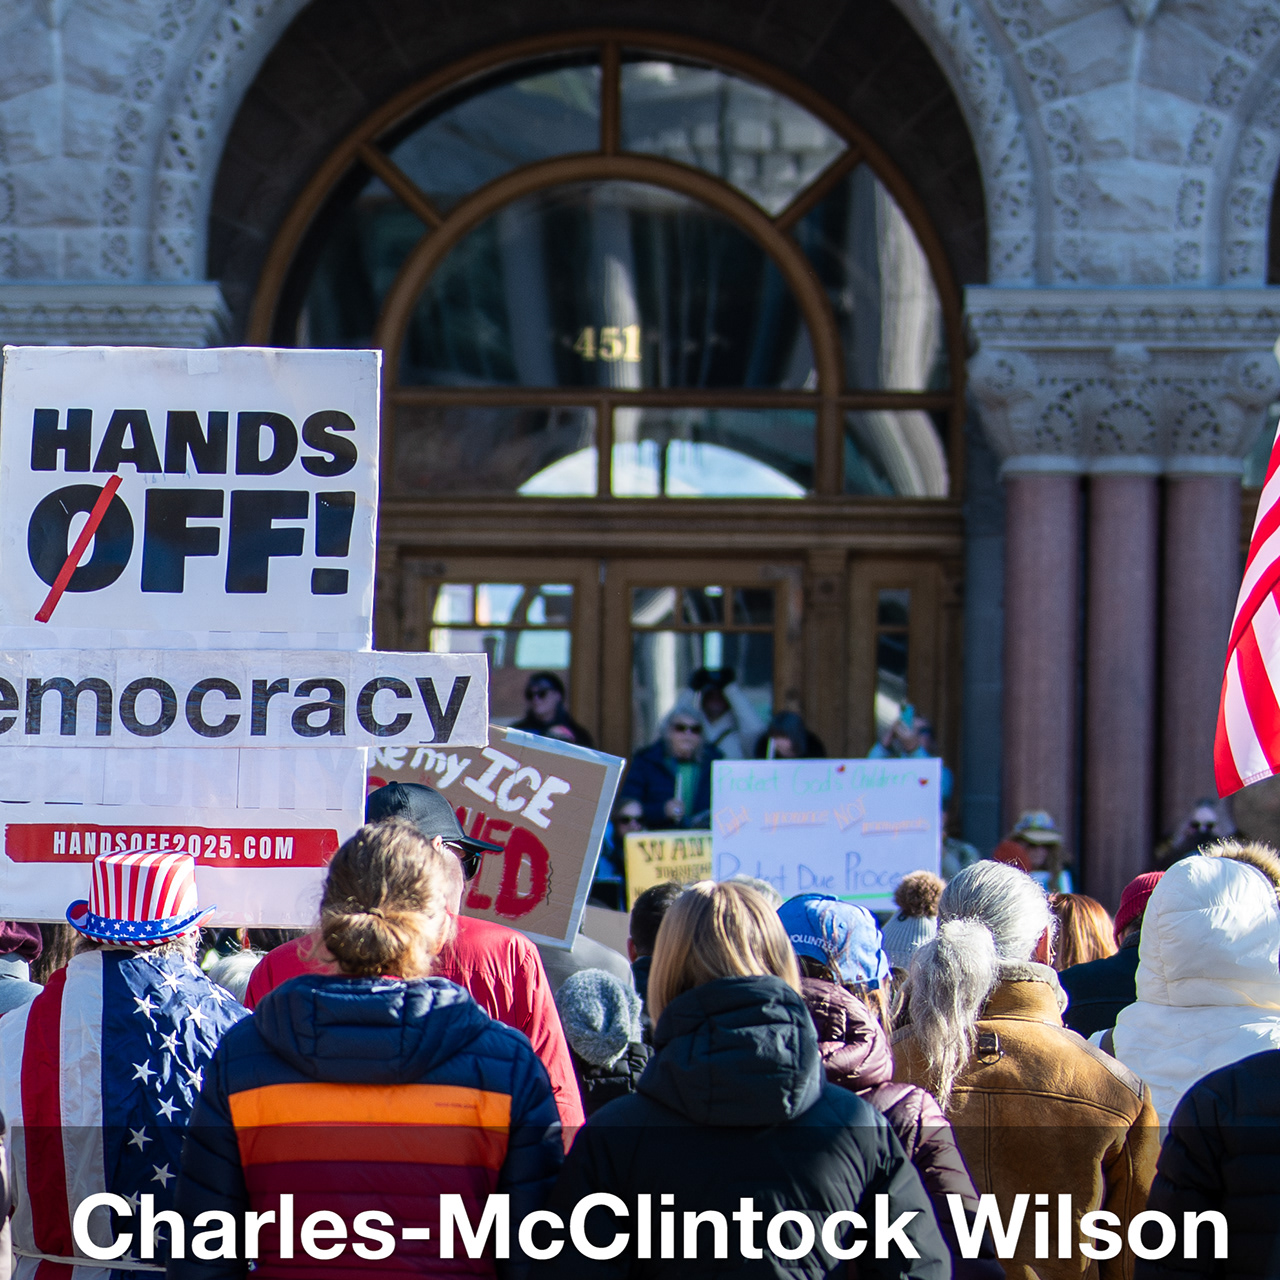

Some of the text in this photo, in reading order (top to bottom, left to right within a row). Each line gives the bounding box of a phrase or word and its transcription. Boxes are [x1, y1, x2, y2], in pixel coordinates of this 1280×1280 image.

[573, 324, 642, 362] 451
[30, 407, 358, 476] HANDS
[27, 484, 357, 594] OFF!
[409, 747, 472, 789] my
[463, 746, 572, 829] ICE
[717, 765, 779, 794] Protect
[831, 793, 868, 828] NOT
[53, 831, 294, 860] HANDSOFF2025.COM
[797, 862, 836, 890] Due
